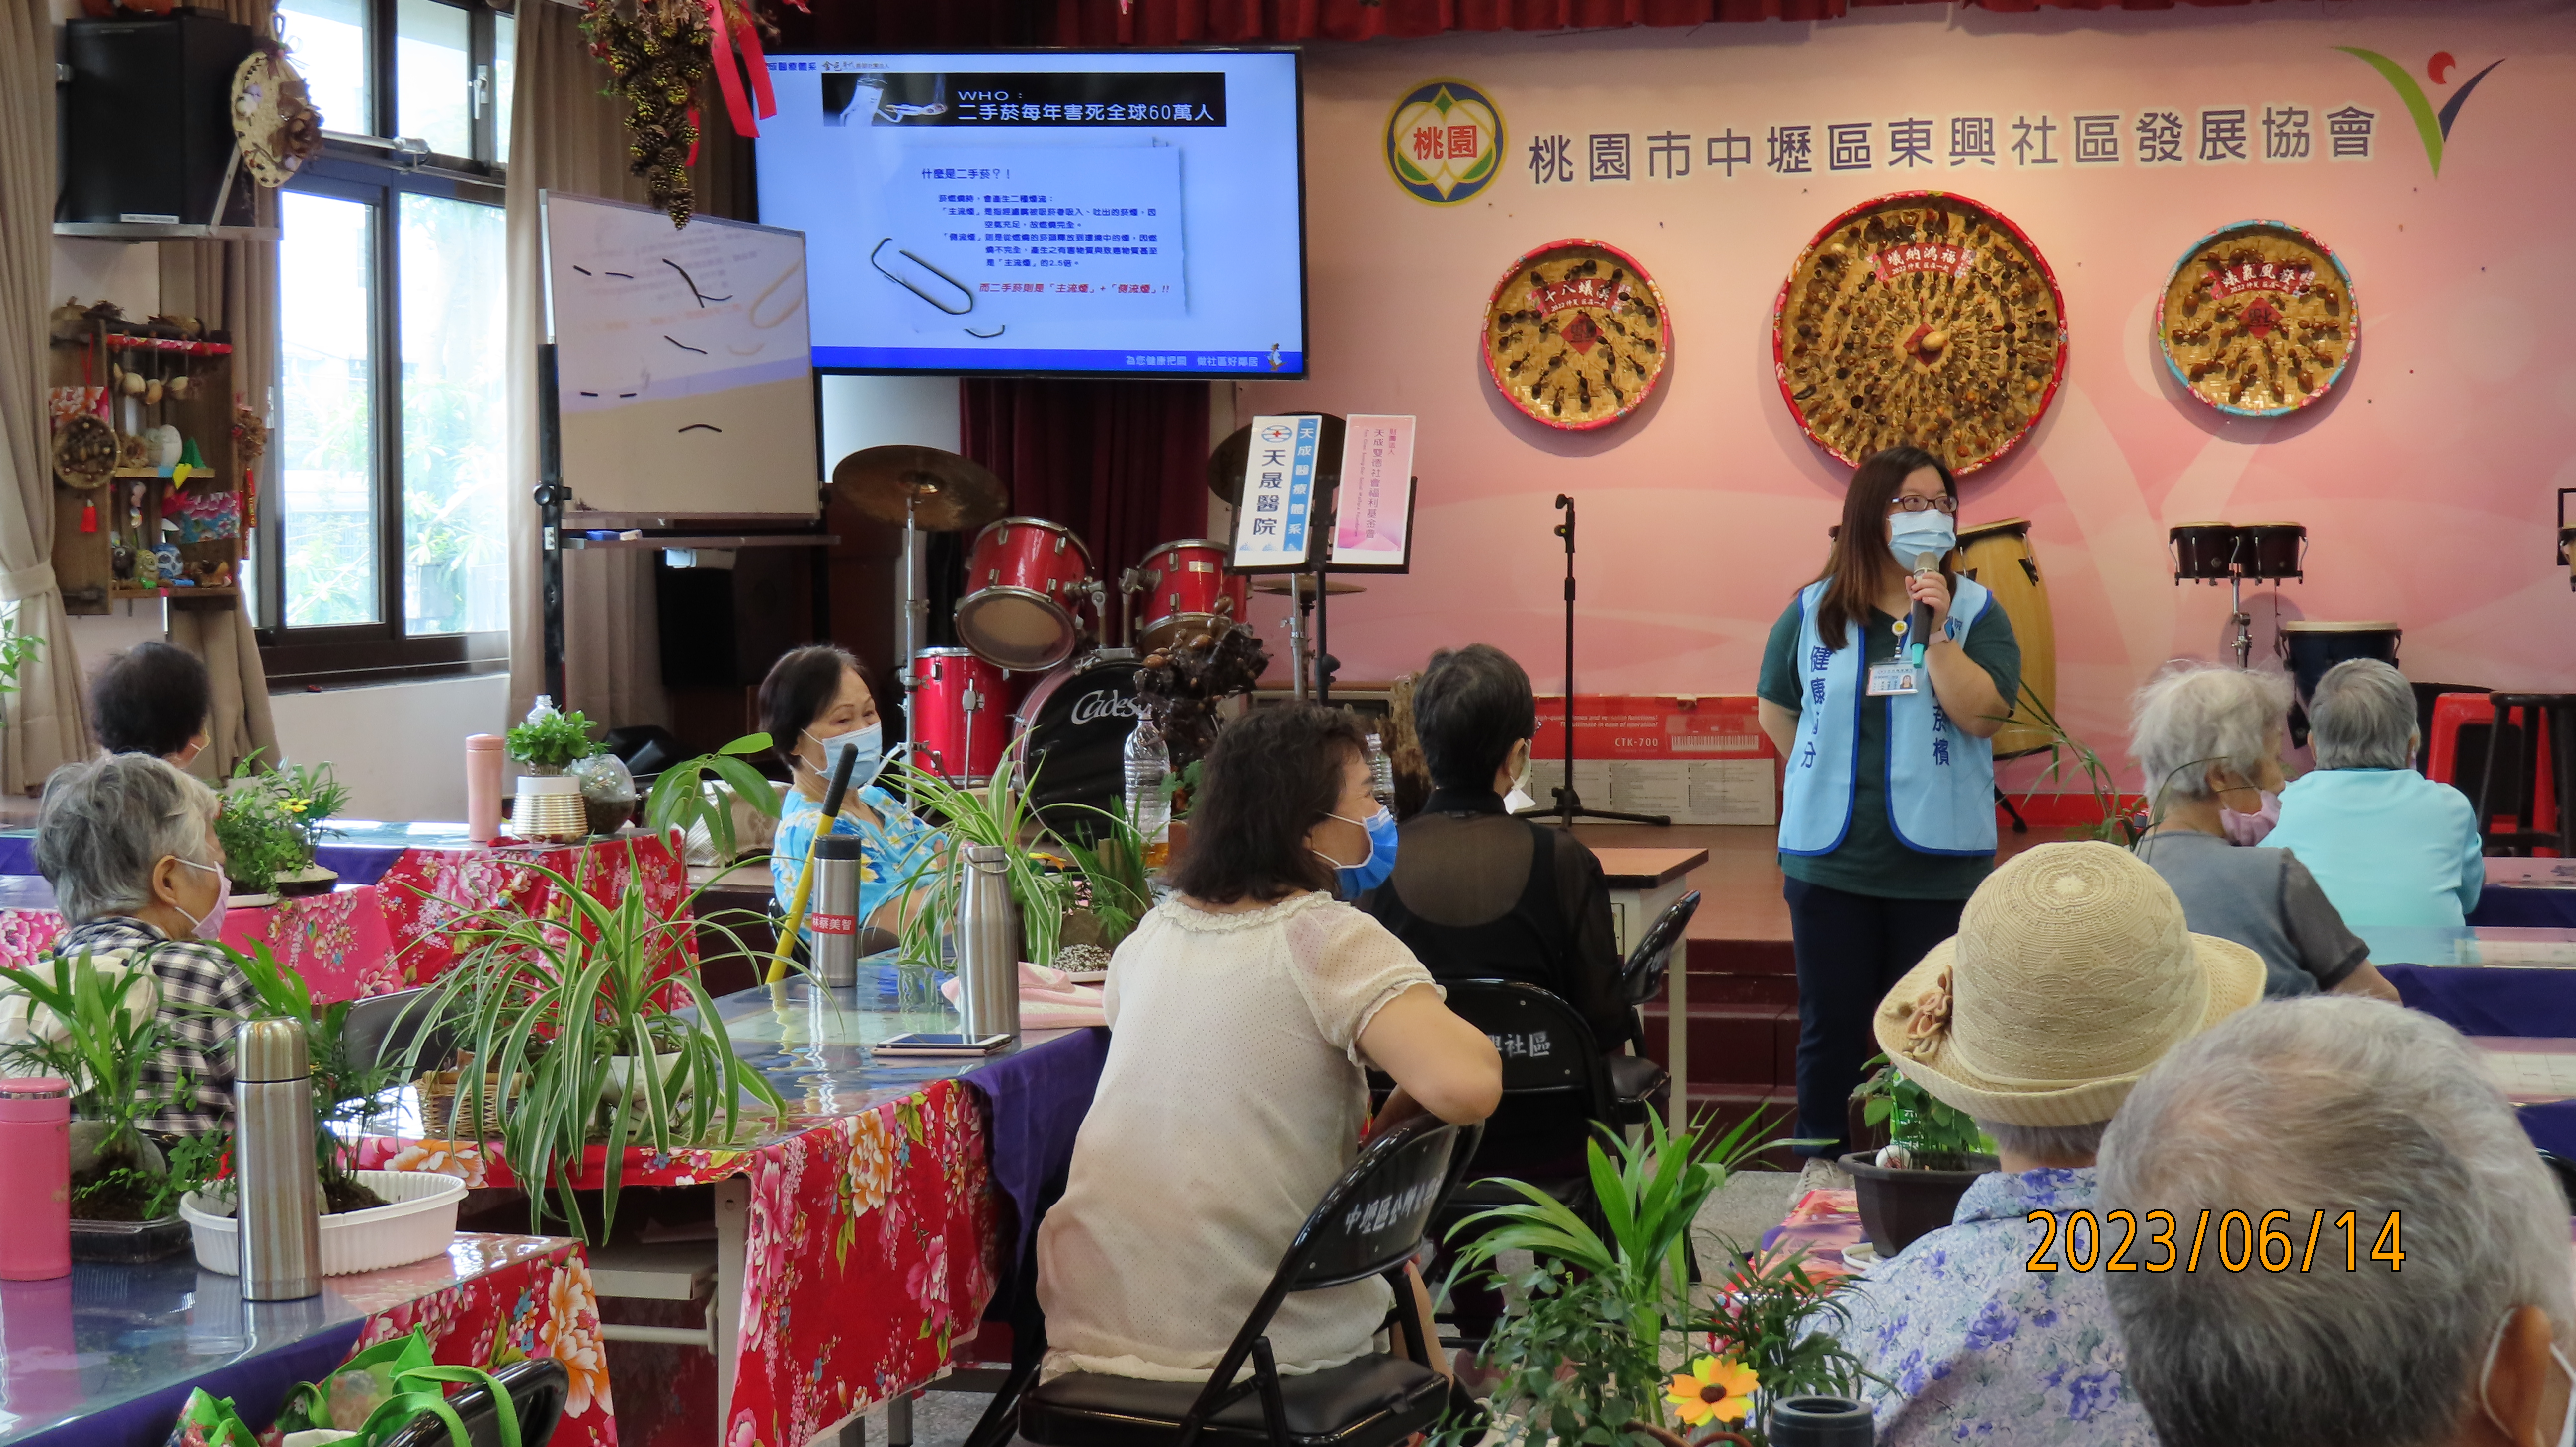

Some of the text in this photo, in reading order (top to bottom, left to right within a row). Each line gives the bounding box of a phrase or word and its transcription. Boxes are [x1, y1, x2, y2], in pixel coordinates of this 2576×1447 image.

[958, 103, 1214, 122] 二手菸每年害死全球60萬人
[1413, 125, 1477, 160] 桃園
[1529, 106, 2375, 184] 桃園市中壢區東興社區發展協會
[1252, 449, 1286, 536] 天晟醫院
[1288, 427, 1315, 536] 天成醫療體系
[1615, 737, 1658, 747] CTK-700
